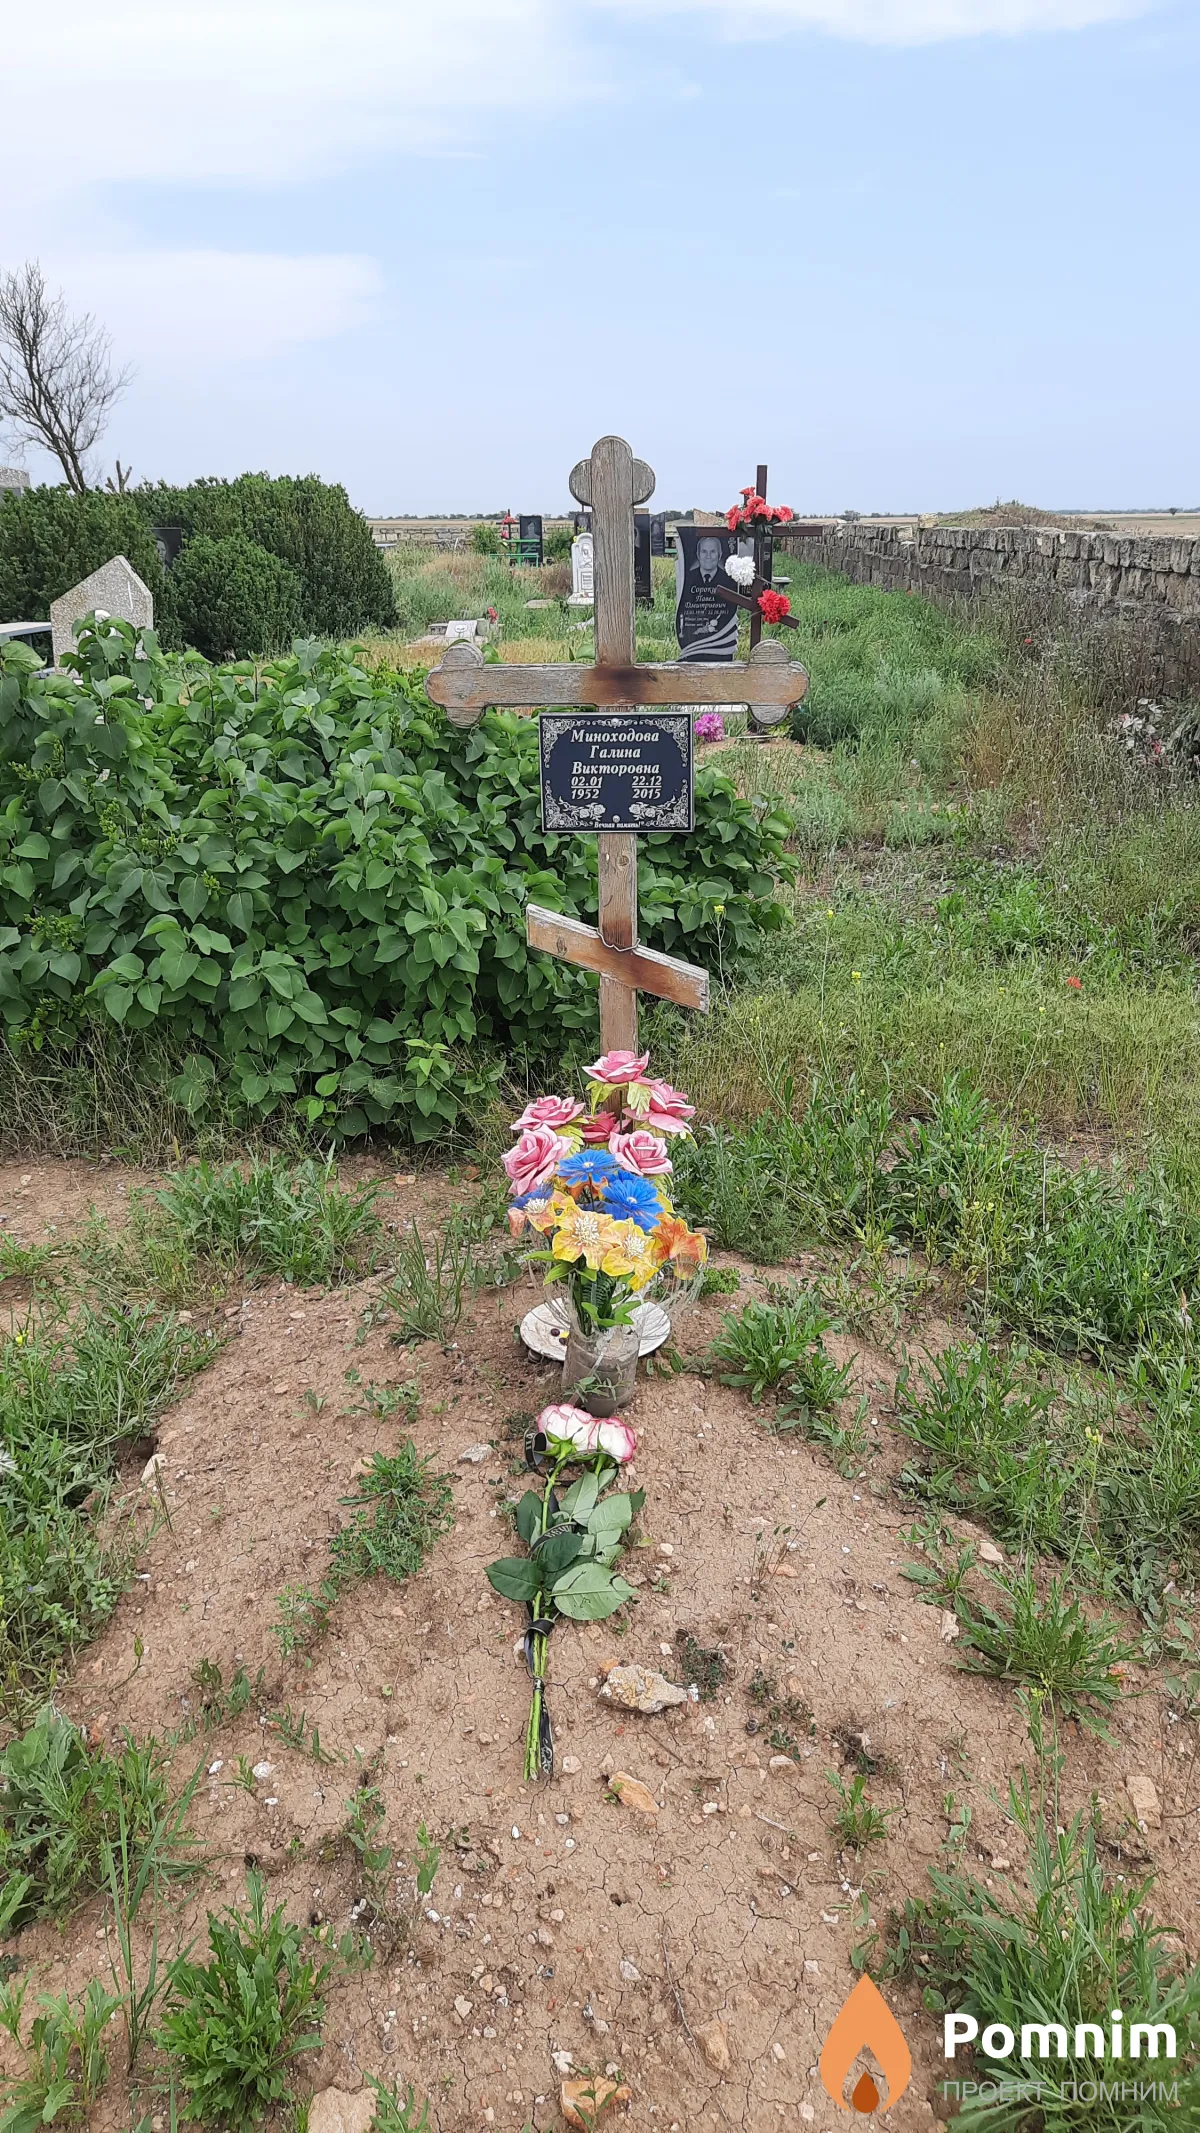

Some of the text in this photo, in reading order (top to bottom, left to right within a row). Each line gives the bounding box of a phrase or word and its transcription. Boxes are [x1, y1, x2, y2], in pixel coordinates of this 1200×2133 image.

[570, 728, 660, 743] Миноходова
[589, 745, 641, 759] Галина
[571, 761, 660, 777] Викторовна
[571, 776, 603, 786] 02.01
[632, 776, 662, 786] 22.12
[571, 789, 600, 800] 1952
[632, 788, 661, 799] 2015
